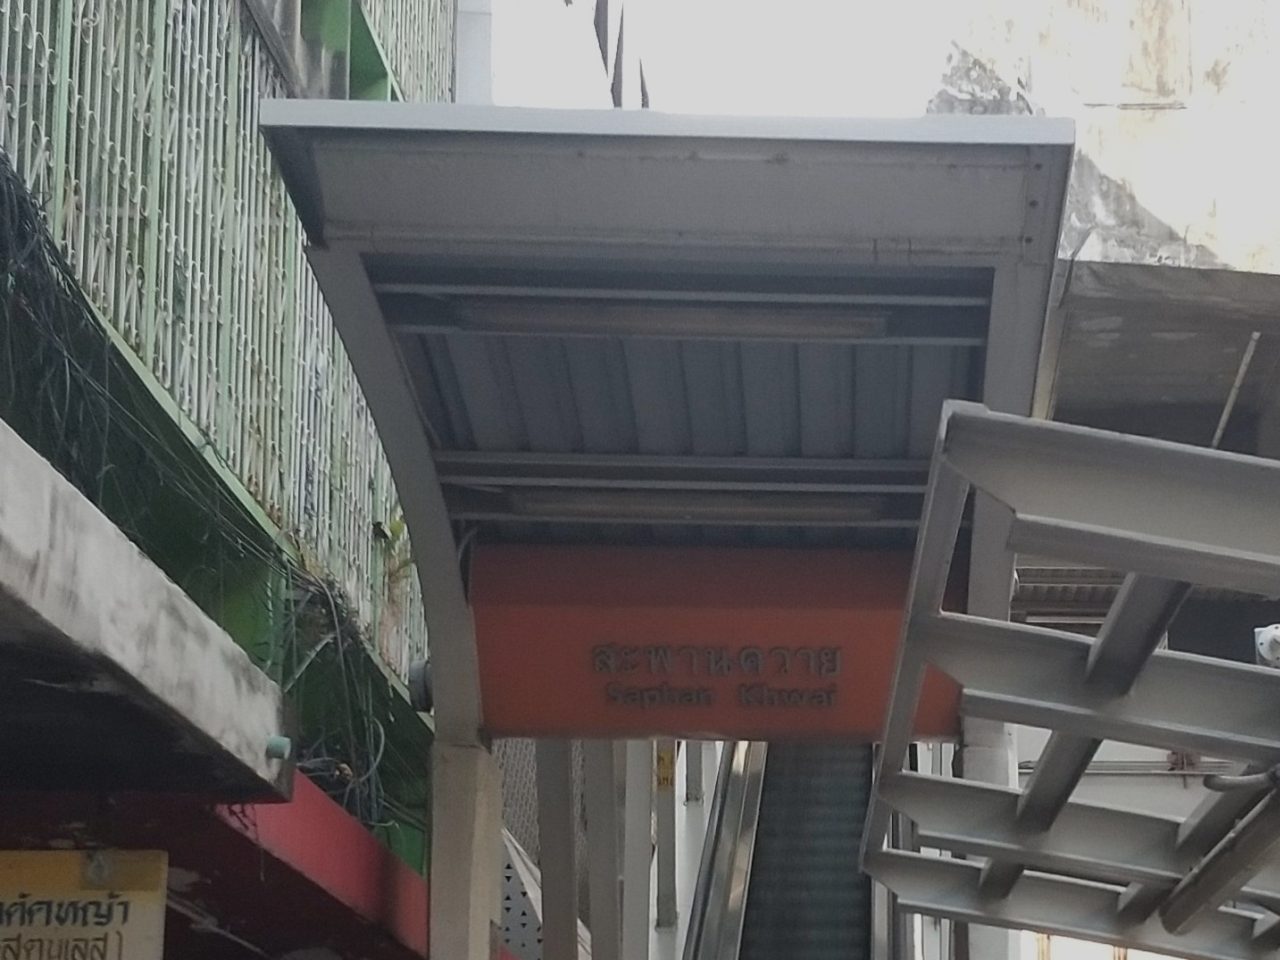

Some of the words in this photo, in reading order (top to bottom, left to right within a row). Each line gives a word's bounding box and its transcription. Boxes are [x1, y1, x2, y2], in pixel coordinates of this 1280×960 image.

[593, 643, 841, 677] สะพานควาย
[606, 681, 712, 709] Saphan
[740, 682, 837, 707] Khwai
